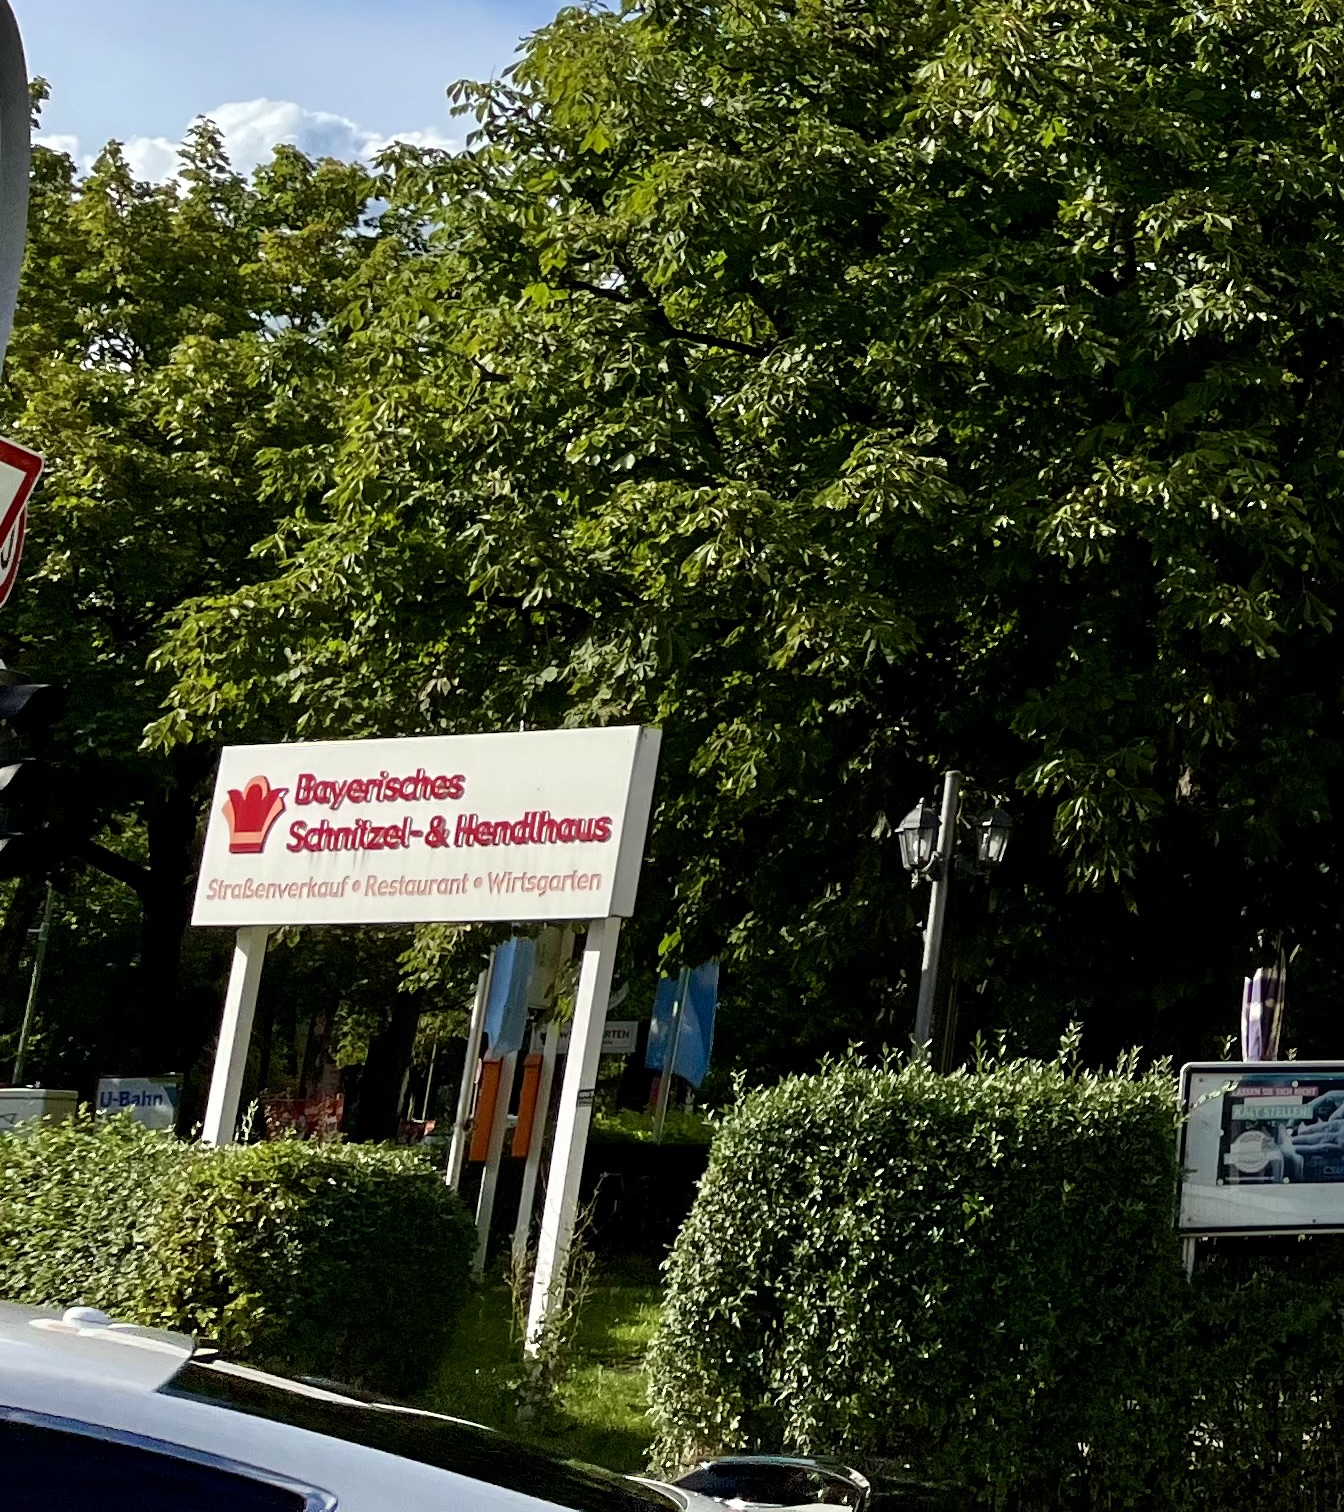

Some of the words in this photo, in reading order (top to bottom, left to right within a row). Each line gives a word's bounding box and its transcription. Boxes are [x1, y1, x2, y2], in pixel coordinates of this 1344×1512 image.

[294, 769, 465, 809] Bayerisches
[286, 816, 423, 853] Schnitzel-
[424, 814, 450, 849] &
[454, 811, 613, 849] Hendlhaus
[207, 874, 356, 901] Straßenverkauf
[365, 873, 468, 897] Restaurant
[488, 871, 602, 898] Wirtsgarten
[101, 1090, 163, 1107] U-Bahn
[1234, 1106, 1260, 1119] KALT
